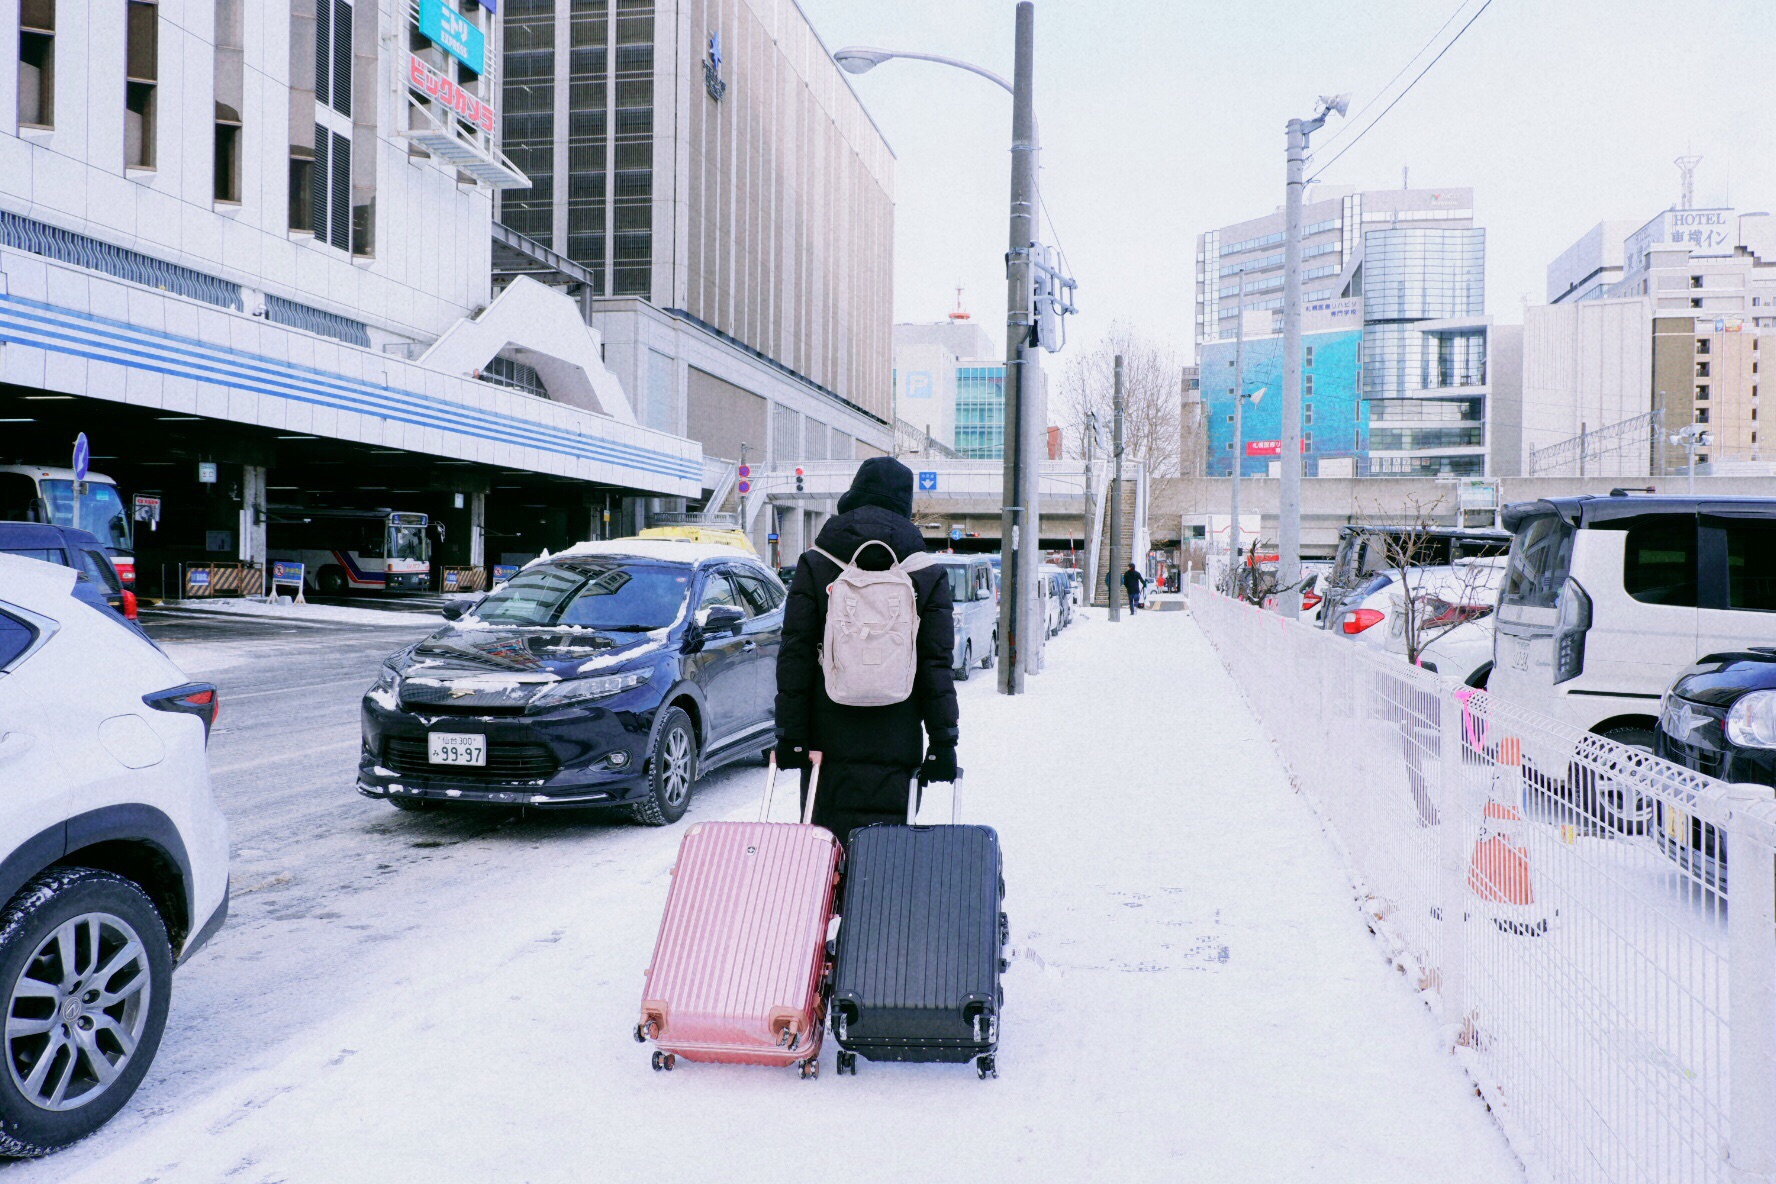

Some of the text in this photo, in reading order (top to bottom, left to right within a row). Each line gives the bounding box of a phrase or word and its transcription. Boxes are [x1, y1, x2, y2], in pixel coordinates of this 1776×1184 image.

[441, 5, 468, 43] ニトリ
[441, 29, 468, 59] EXPRESS
[410, 55, 493, 132] ビックカメラ
[1673, 212, 1726, 226] HOTEL
[910, 375, 929, 395] P
[459, 737, 473, 746] 300
[441, 746, 482, 763] 99-97
